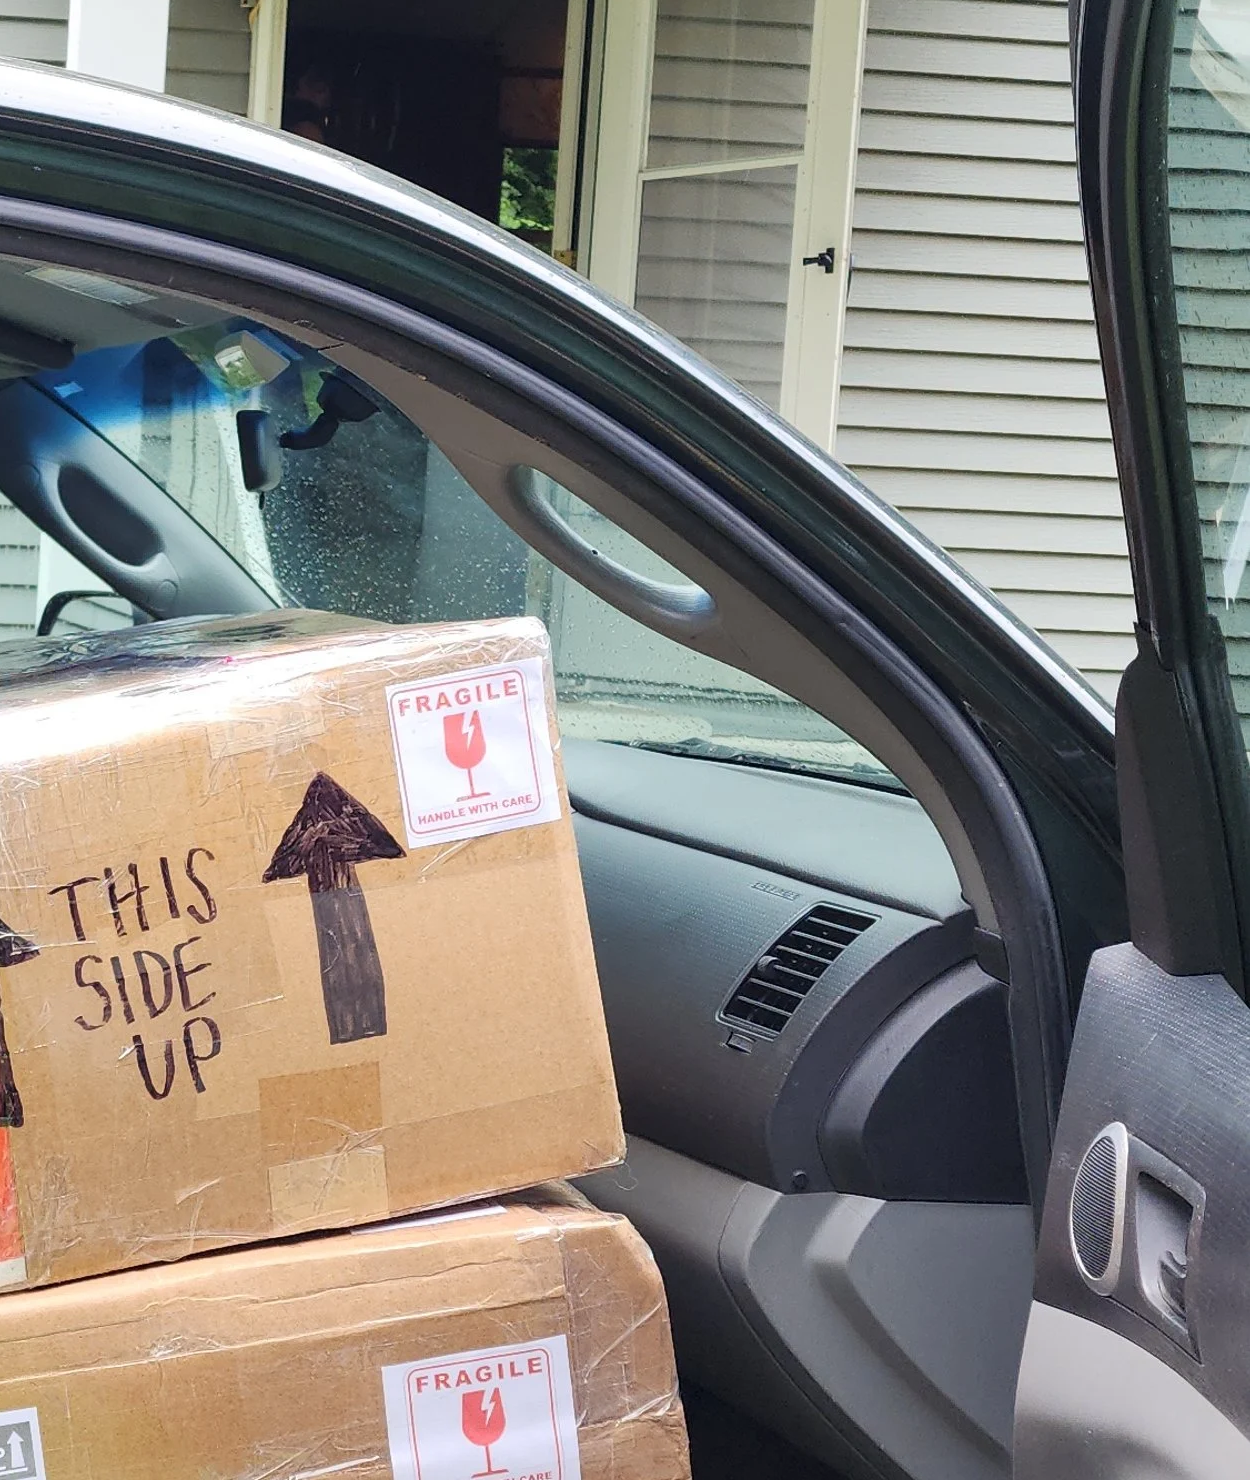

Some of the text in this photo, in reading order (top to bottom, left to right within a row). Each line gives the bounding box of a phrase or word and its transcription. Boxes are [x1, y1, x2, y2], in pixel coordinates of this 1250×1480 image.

[397, 678, 519, 717] FRAGILE
[417, 793, 533, 825] HANDLE WITH CARE
[47, 847, 218, 942] THIS
[73, 935, 217, 1031] SIDE
[132, 1016, 222, 1100] UP
[415, 1356, 543, 1394] FRAGILE
